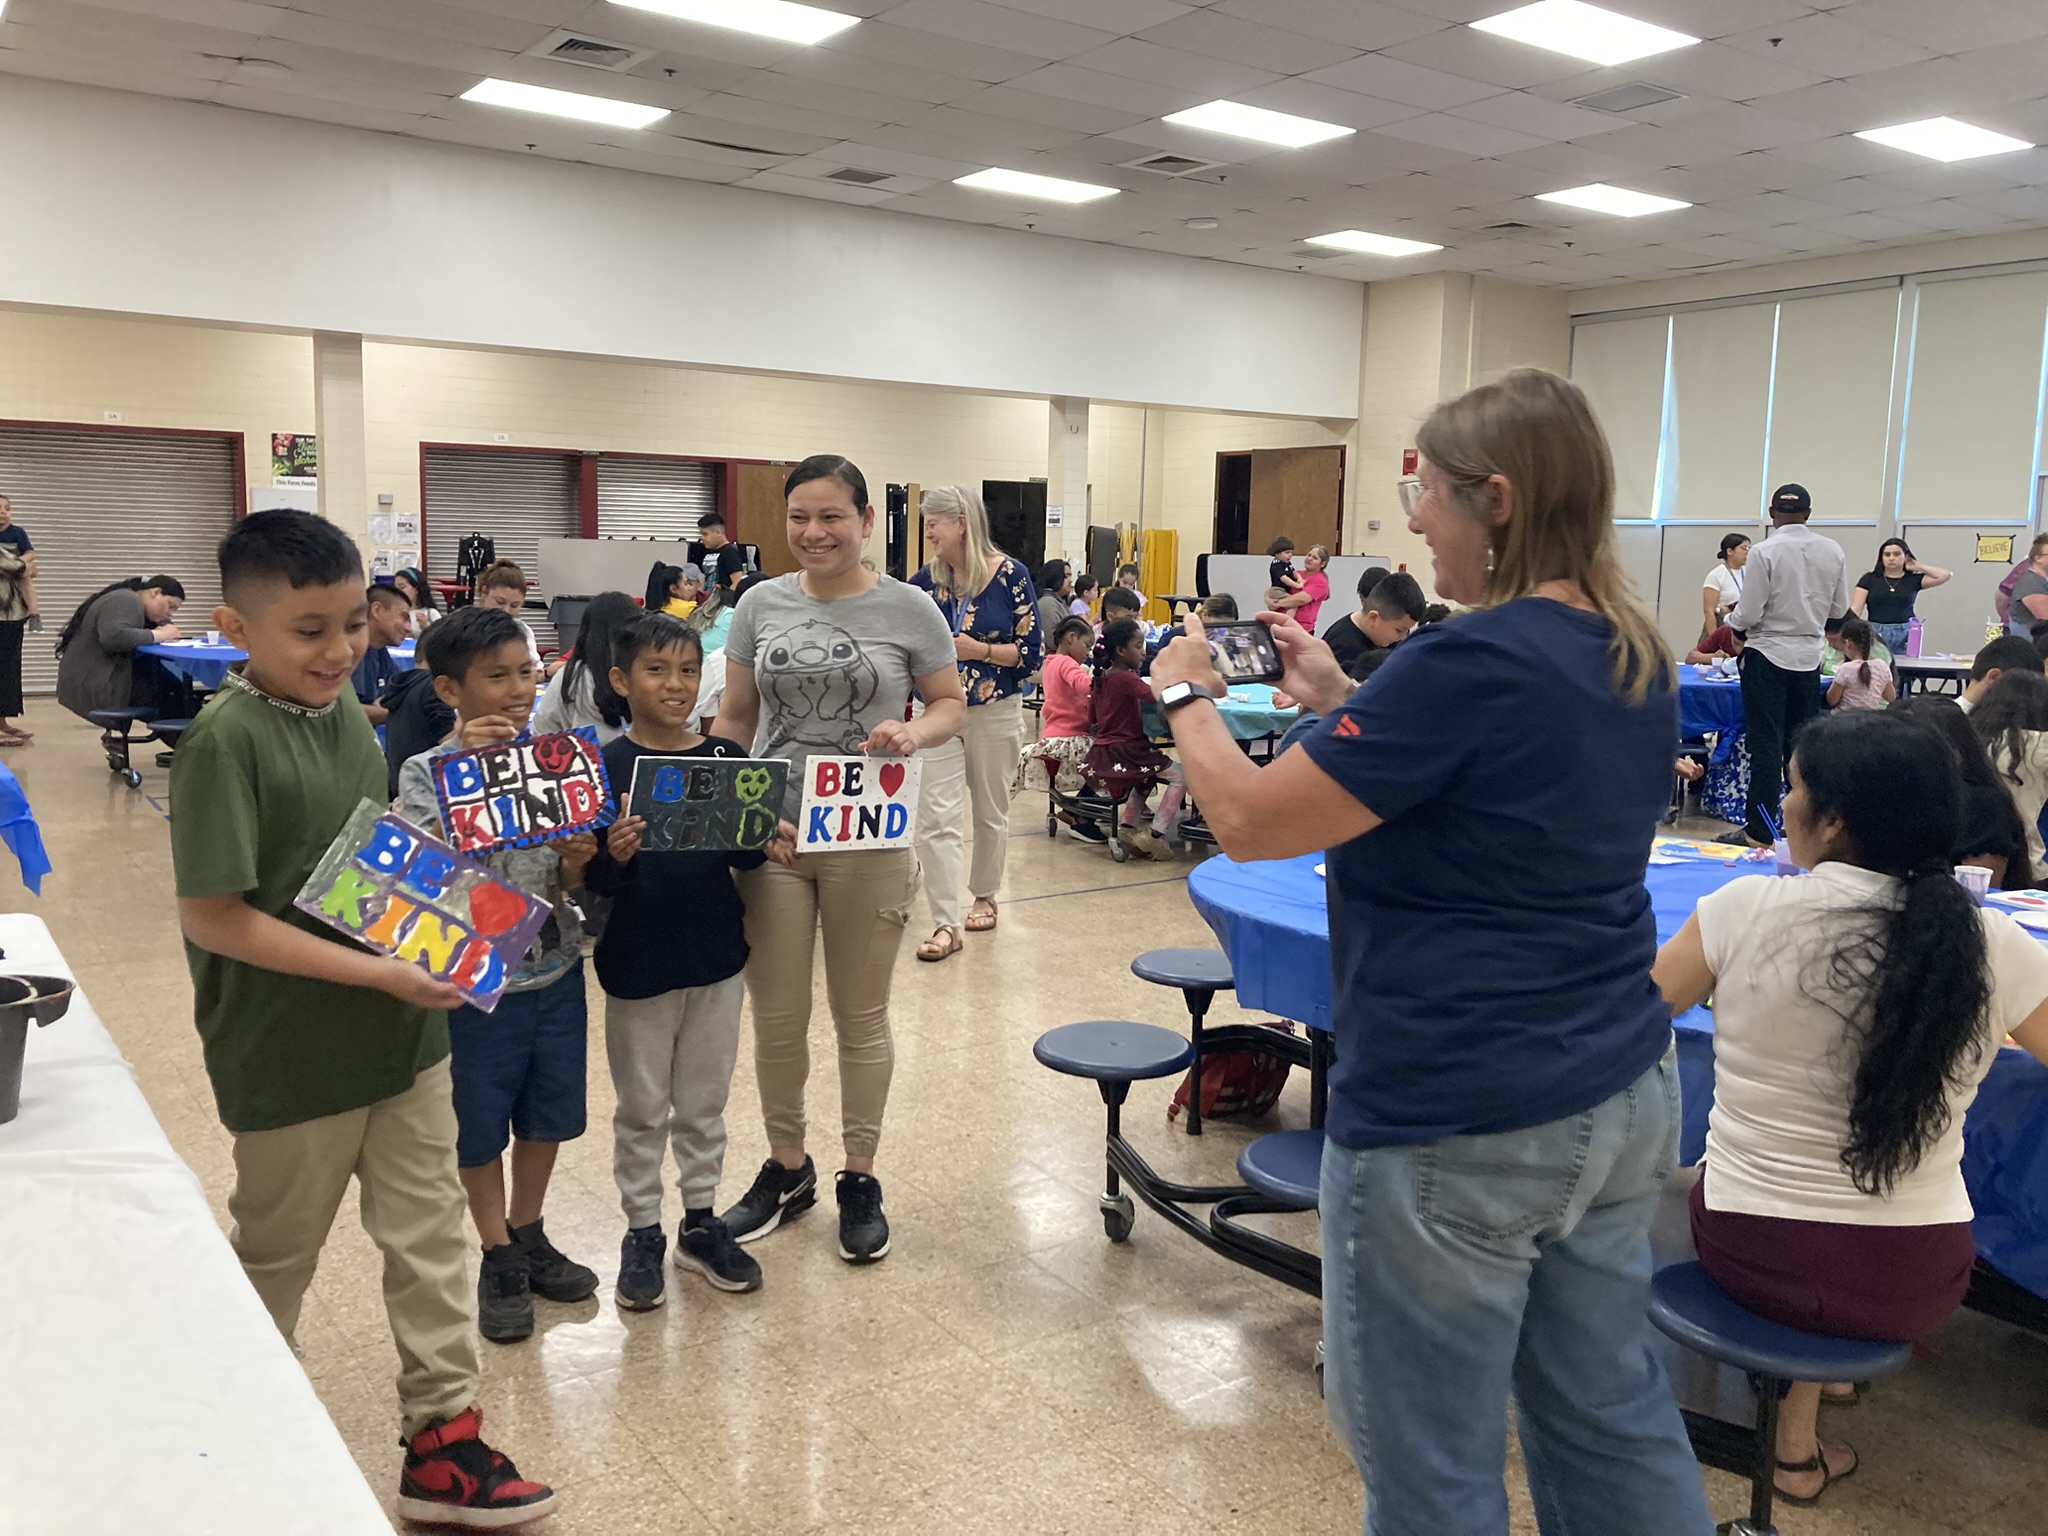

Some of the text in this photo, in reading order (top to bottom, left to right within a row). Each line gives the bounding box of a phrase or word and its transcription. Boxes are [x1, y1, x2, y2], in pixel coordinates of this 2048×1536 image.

[1979, 541, 2008, 556] BELIEVE
[267, 697, 301, 715] GOOD
[443, 747, 520, 797] BE
[652, 764, 721, 804] BE
[815, 761, 864, 798] BE
[450, 779, 600, 851] KIND
[806, 802, 908, 844] KIND
[355, 820, 456, 900] BE
[318, 866, 508, 994] KIND
